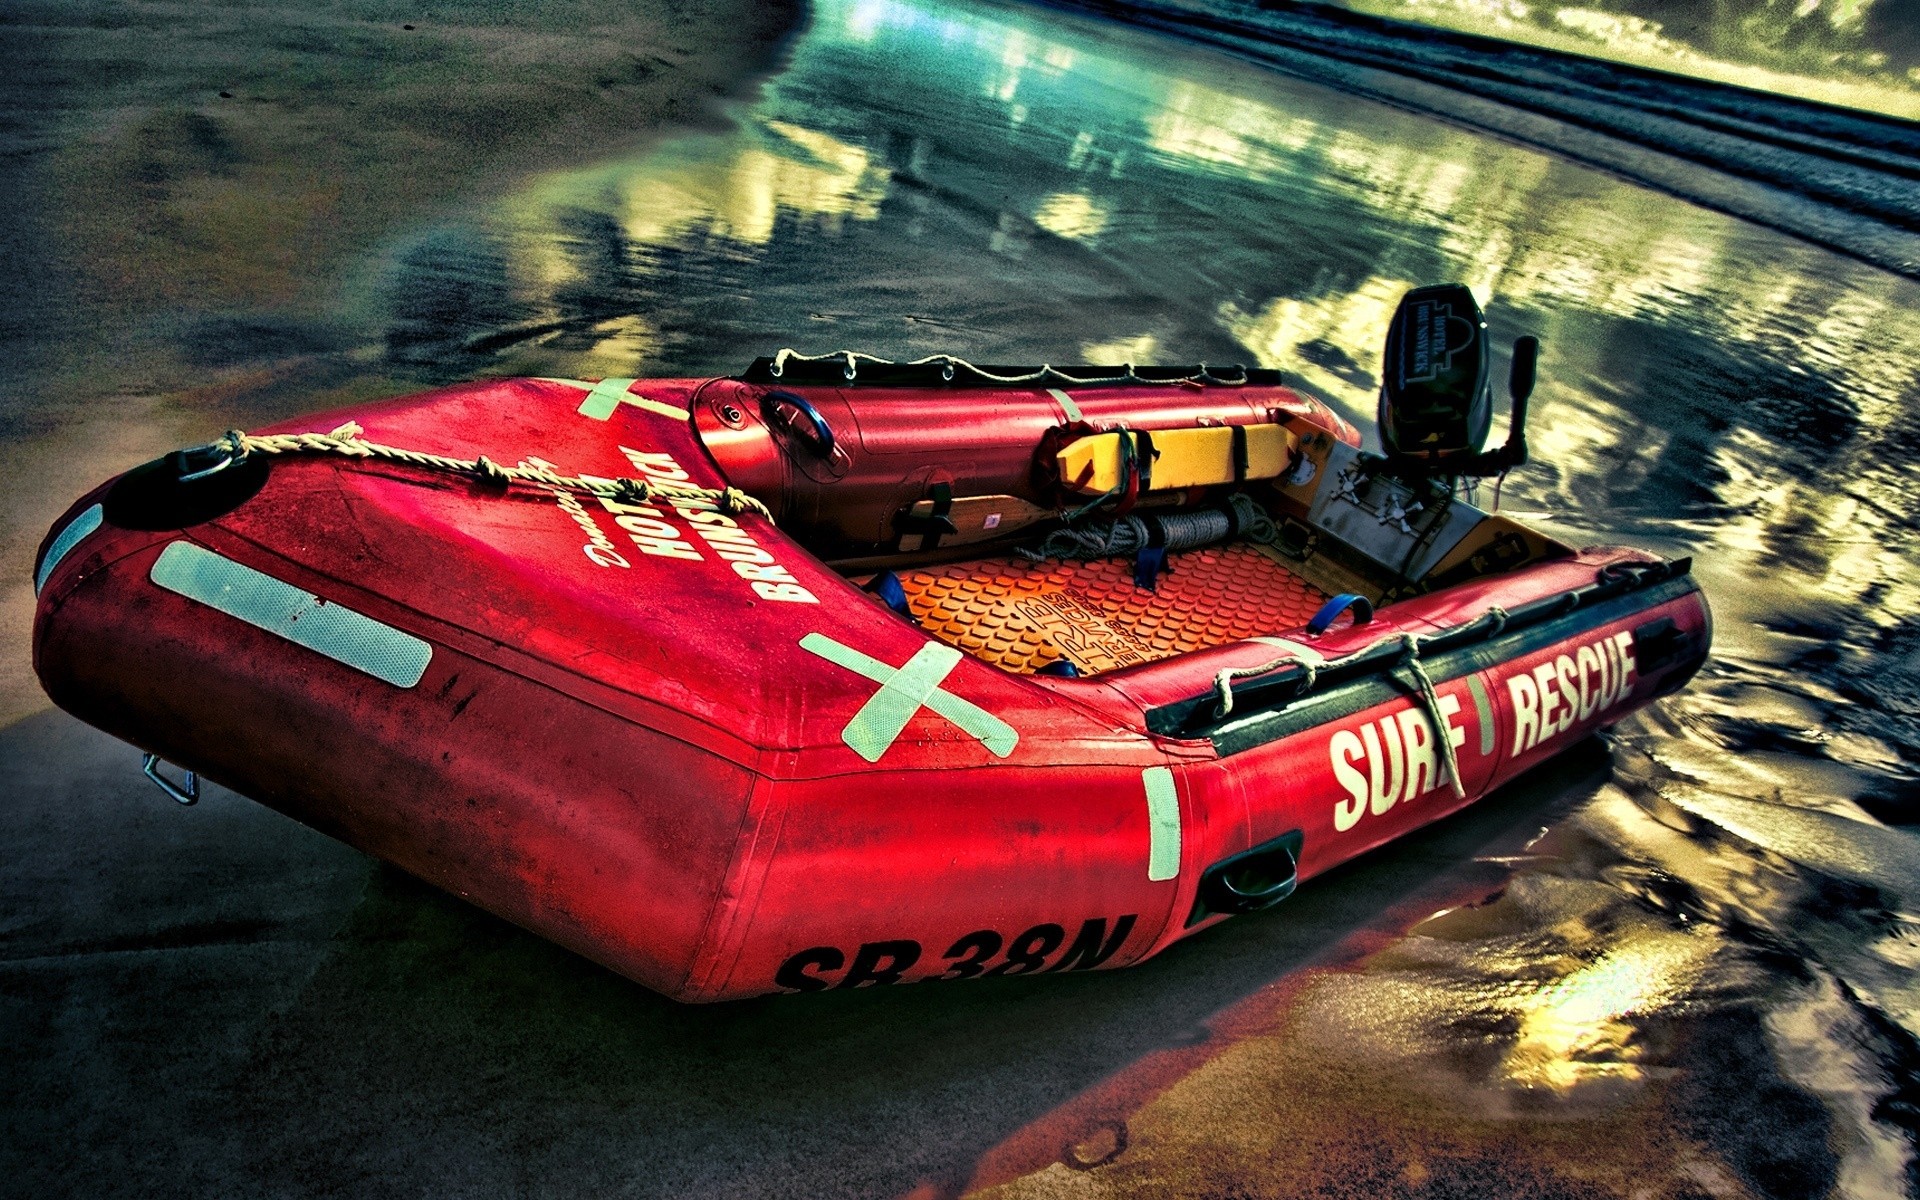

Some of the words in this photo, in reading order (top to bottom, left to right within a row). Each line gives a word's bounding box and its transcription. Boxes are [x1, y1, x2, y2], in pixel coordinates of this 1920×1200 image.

[1414, 305, 1430, 374] BRUNSWICK
[1432, 316, 1447, 355] HOTEL
[1042, 592, 1147, 664] ERVICES
[1330, 693, 1466, 832] SURF
[1506, 630, 1636, 758] RESCUE
